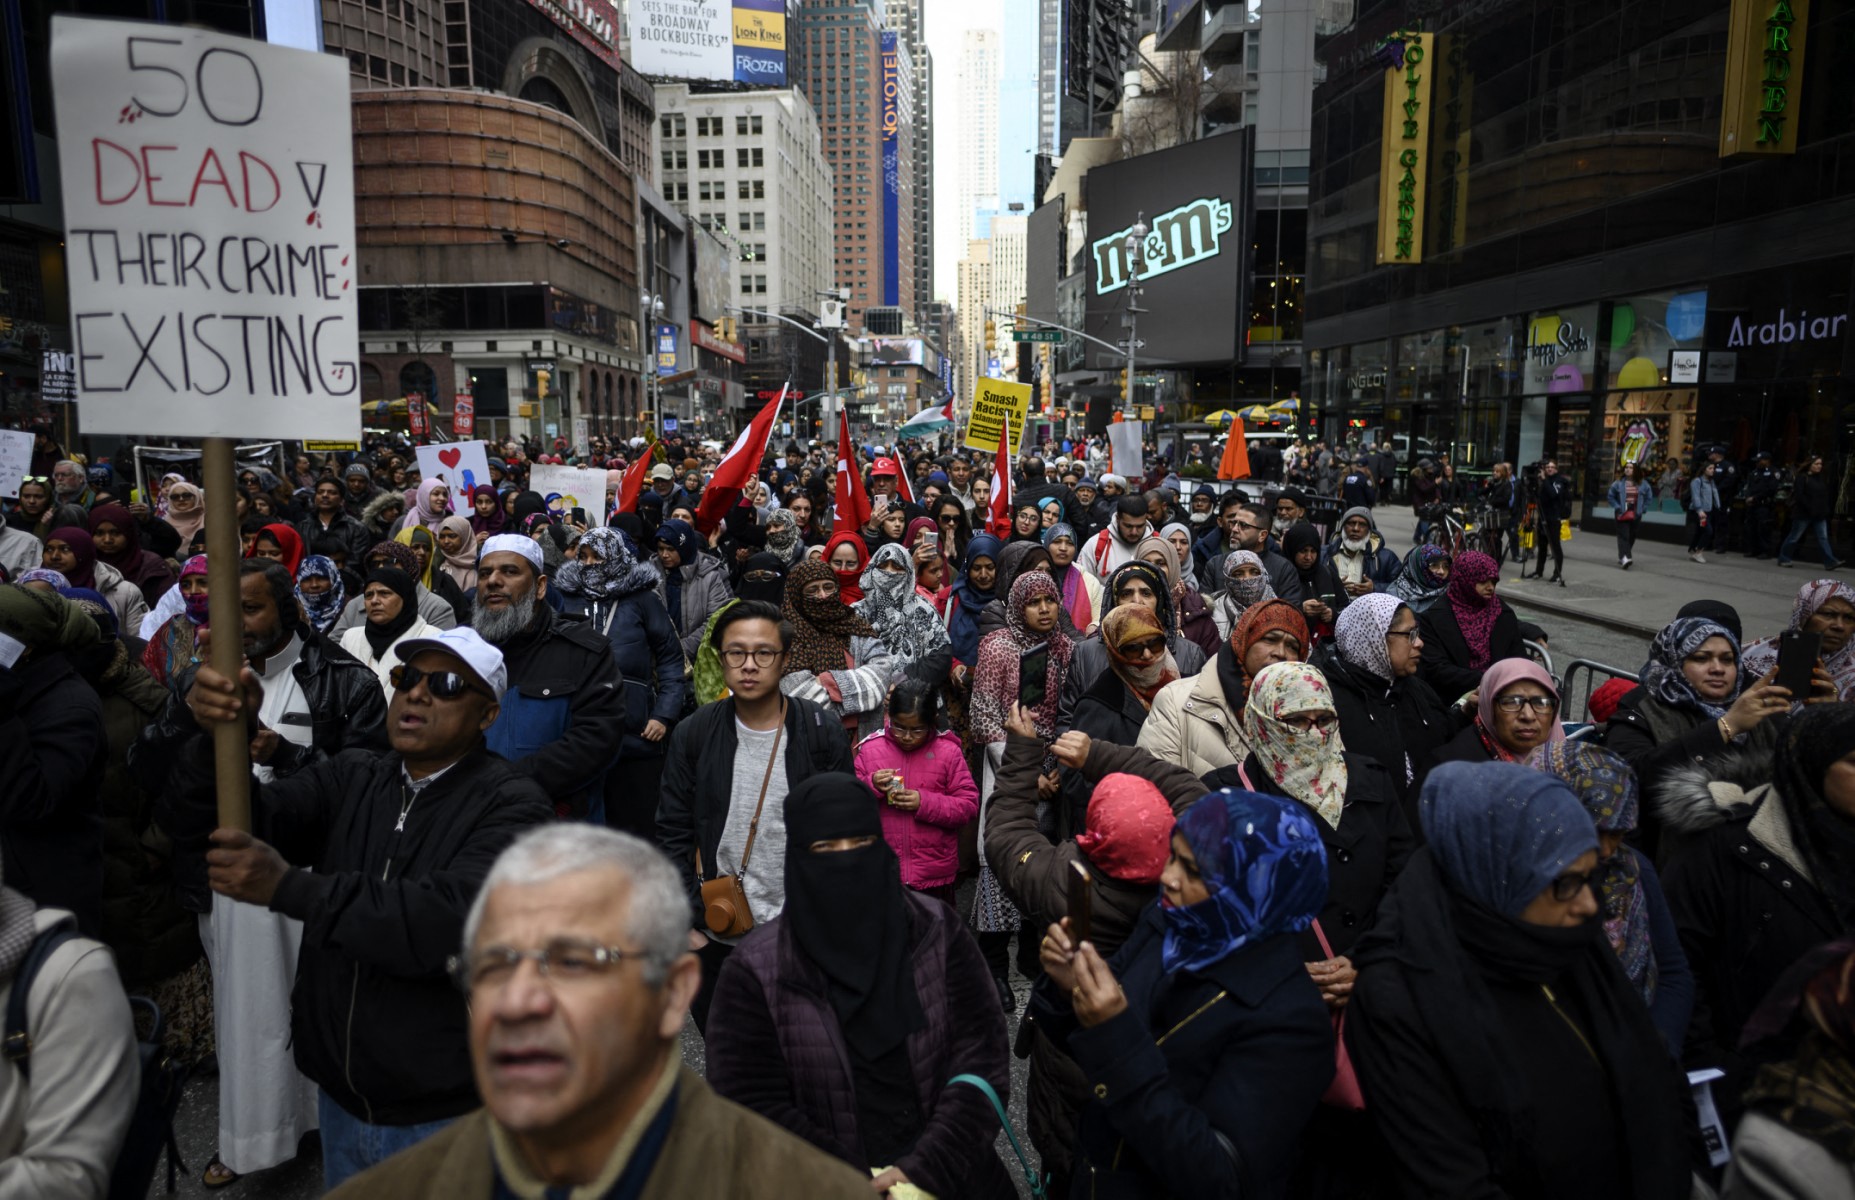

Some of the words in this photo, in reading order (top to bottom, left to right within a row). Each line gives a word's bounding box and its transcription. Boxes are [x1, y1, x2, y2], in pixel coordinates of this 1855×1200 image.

[642, 1, 661, 12] SETS
[664, 3, 679, 15] THE
[682, 5, 698, 17] BAR
[702, 7, 717, 19] FOR
[650, 13, 710, 32] BROADWAY
[753, 19, 763, 27] THE
[127, 36, 264, 127] 50
[736, 55, 784, 74] FROZEN
[881, 44, 897, 141] NOVOTEL
[1402, 45, 1424, 139] OLIVE
[1395, 148, 1418, 259] GARDEN
[70, 229, 210, 290] THEIR
[76, 311, 357, 397] EXISTING
[1524, 324, 1557, 367] Happy
[976, 401, 1014, 418] Racism
[1015, 410, 1022, 419] &
[983, 390, 1018, 406] Smash
